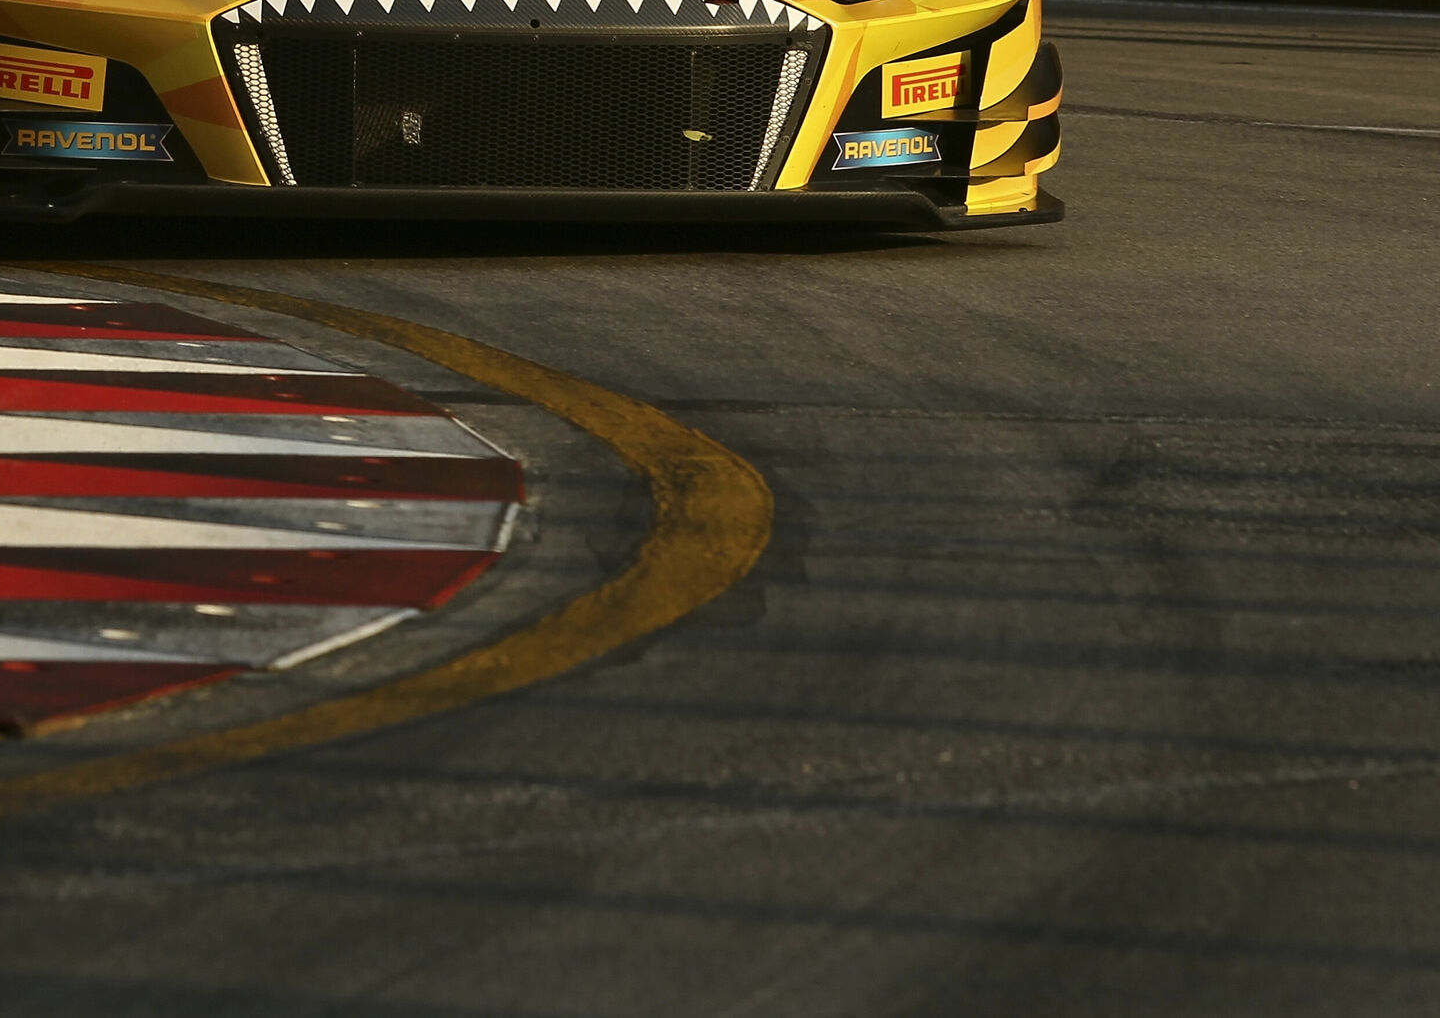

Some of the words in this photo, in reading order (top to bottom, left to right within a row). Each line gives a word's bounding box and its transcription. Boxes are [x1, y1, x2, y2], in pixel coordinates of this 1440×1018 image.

[892, 64, 965, 106] PIRELLI
[17, 129, 156, 151] RAVENOL
[844, 136, 933, 160] RAVENOL
